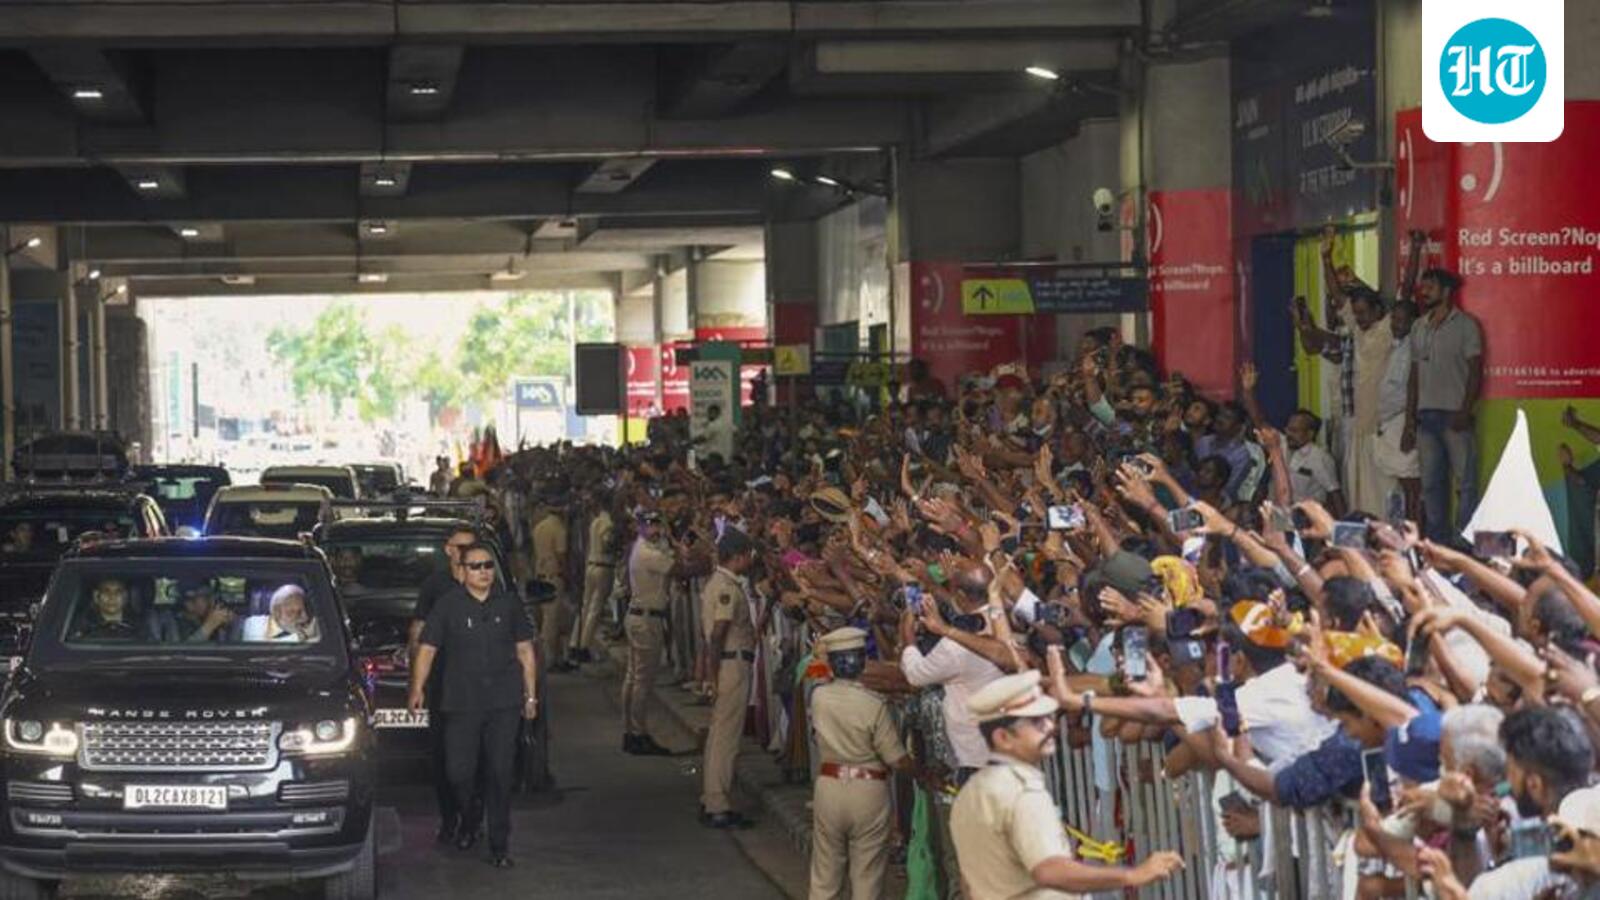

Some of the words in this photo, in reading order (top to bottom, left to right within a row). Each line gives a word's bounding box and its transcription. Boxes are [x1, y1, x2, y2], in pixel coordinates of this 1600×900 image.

[1458, 227, 1492, 246] Red
[1499, 226, 1600, 250] Screen?No
[1459, 256, 1486, 275] It's
[1491, 261, 1503, 275] a
[1509, 255, 1593, 275] billboard
[135, 787, 225, 806] DL2CAX8121
